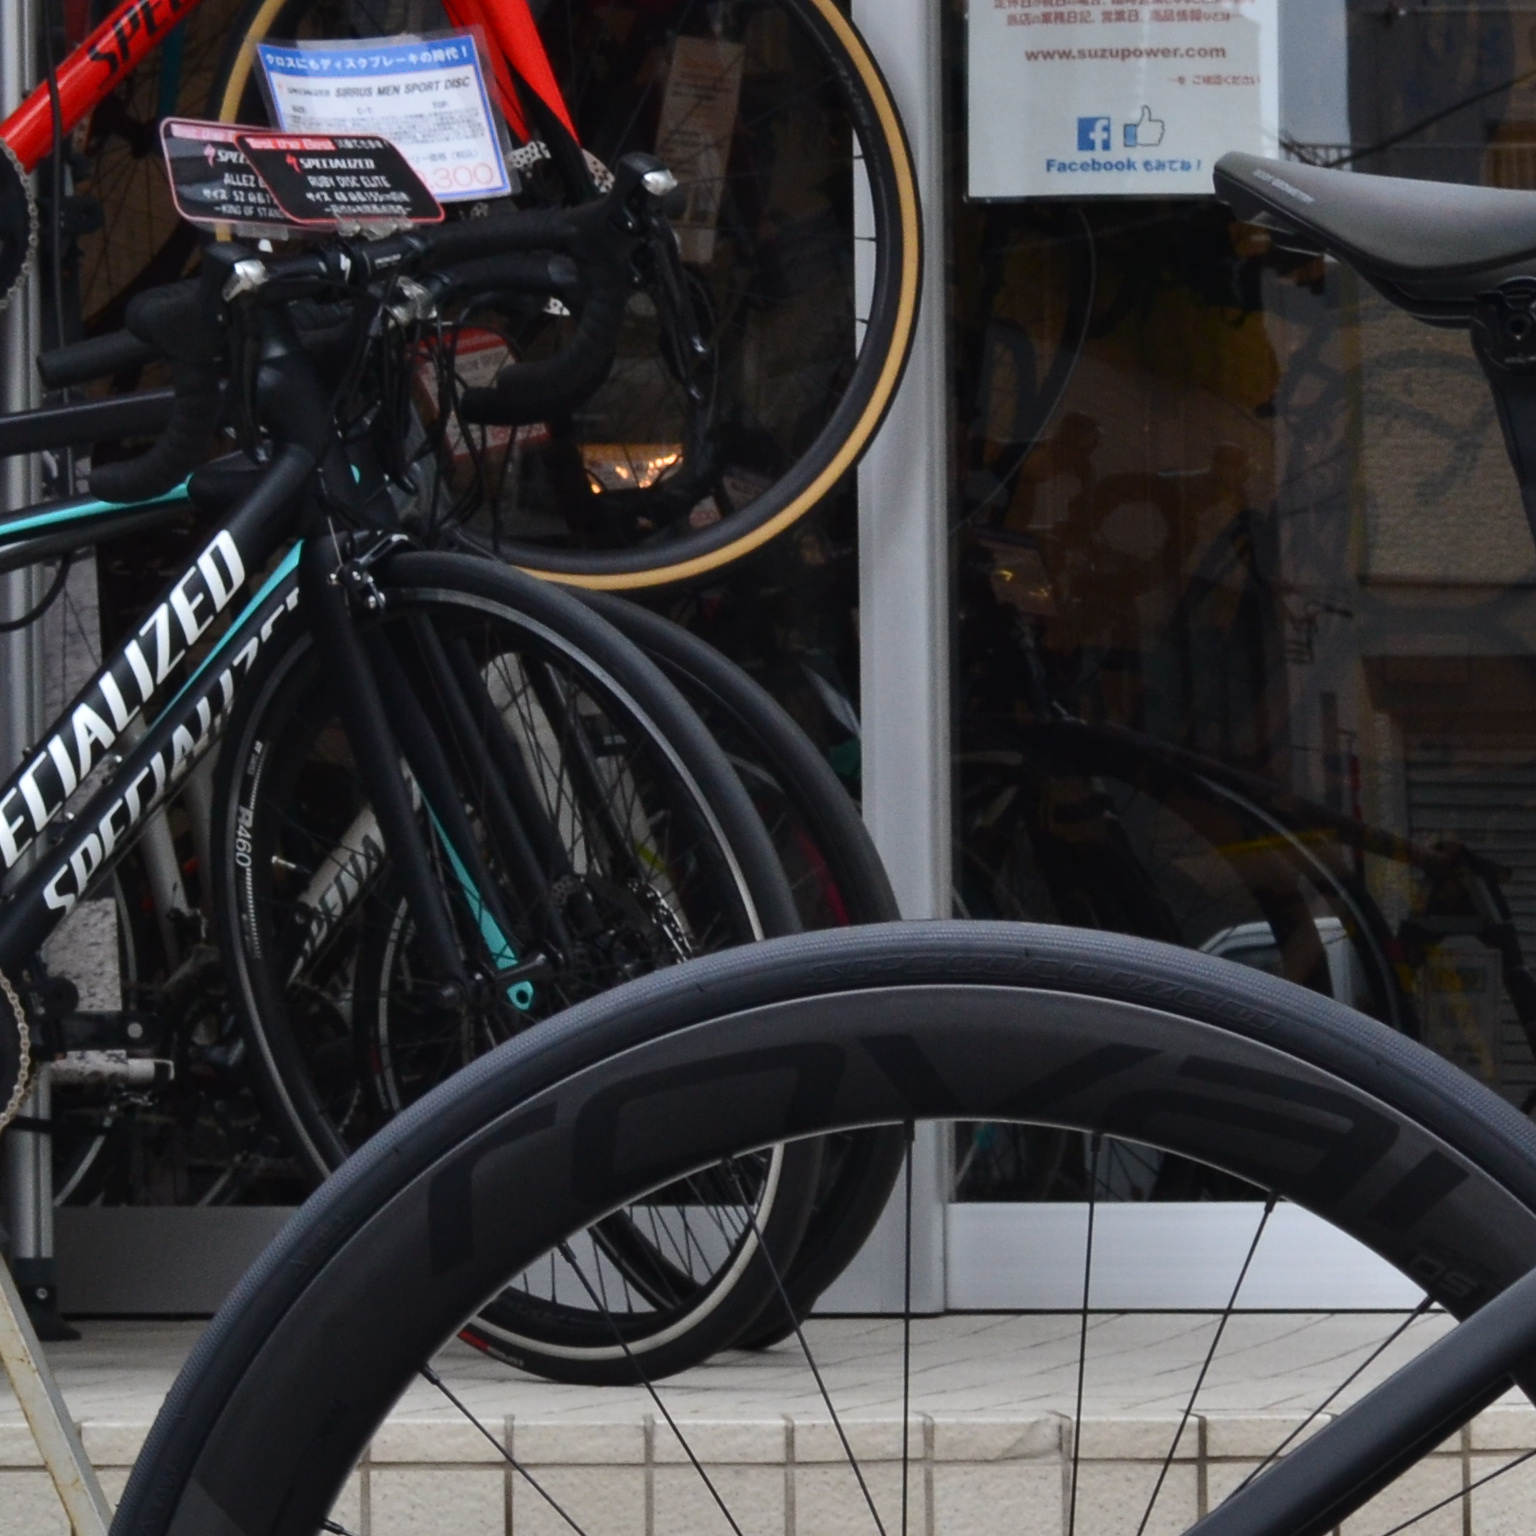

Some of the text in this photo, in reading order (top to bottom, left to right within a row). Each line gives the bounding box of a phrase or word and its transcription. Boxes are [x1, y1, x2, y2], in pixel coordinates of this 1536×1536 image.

[88, 0, 185, 74] SPE
[1024, 45, 1227, 62] www.suzupower.com
[335, 84, 373, 98] SIRRUS
[377, 83, 400, 97] MEN
[405, 80, 440, 95] SPORT
[444, 76, 471, 91] DISC
[300, 157, 376, 170] SPECIALIZED
[1046, 158, 1137, 174] Facebook
[224, 172, 255, 187] ALLEZ
[309, 175, 392, 189] RUBY DISC ELITE
[235, 803, 254, 868] R460
